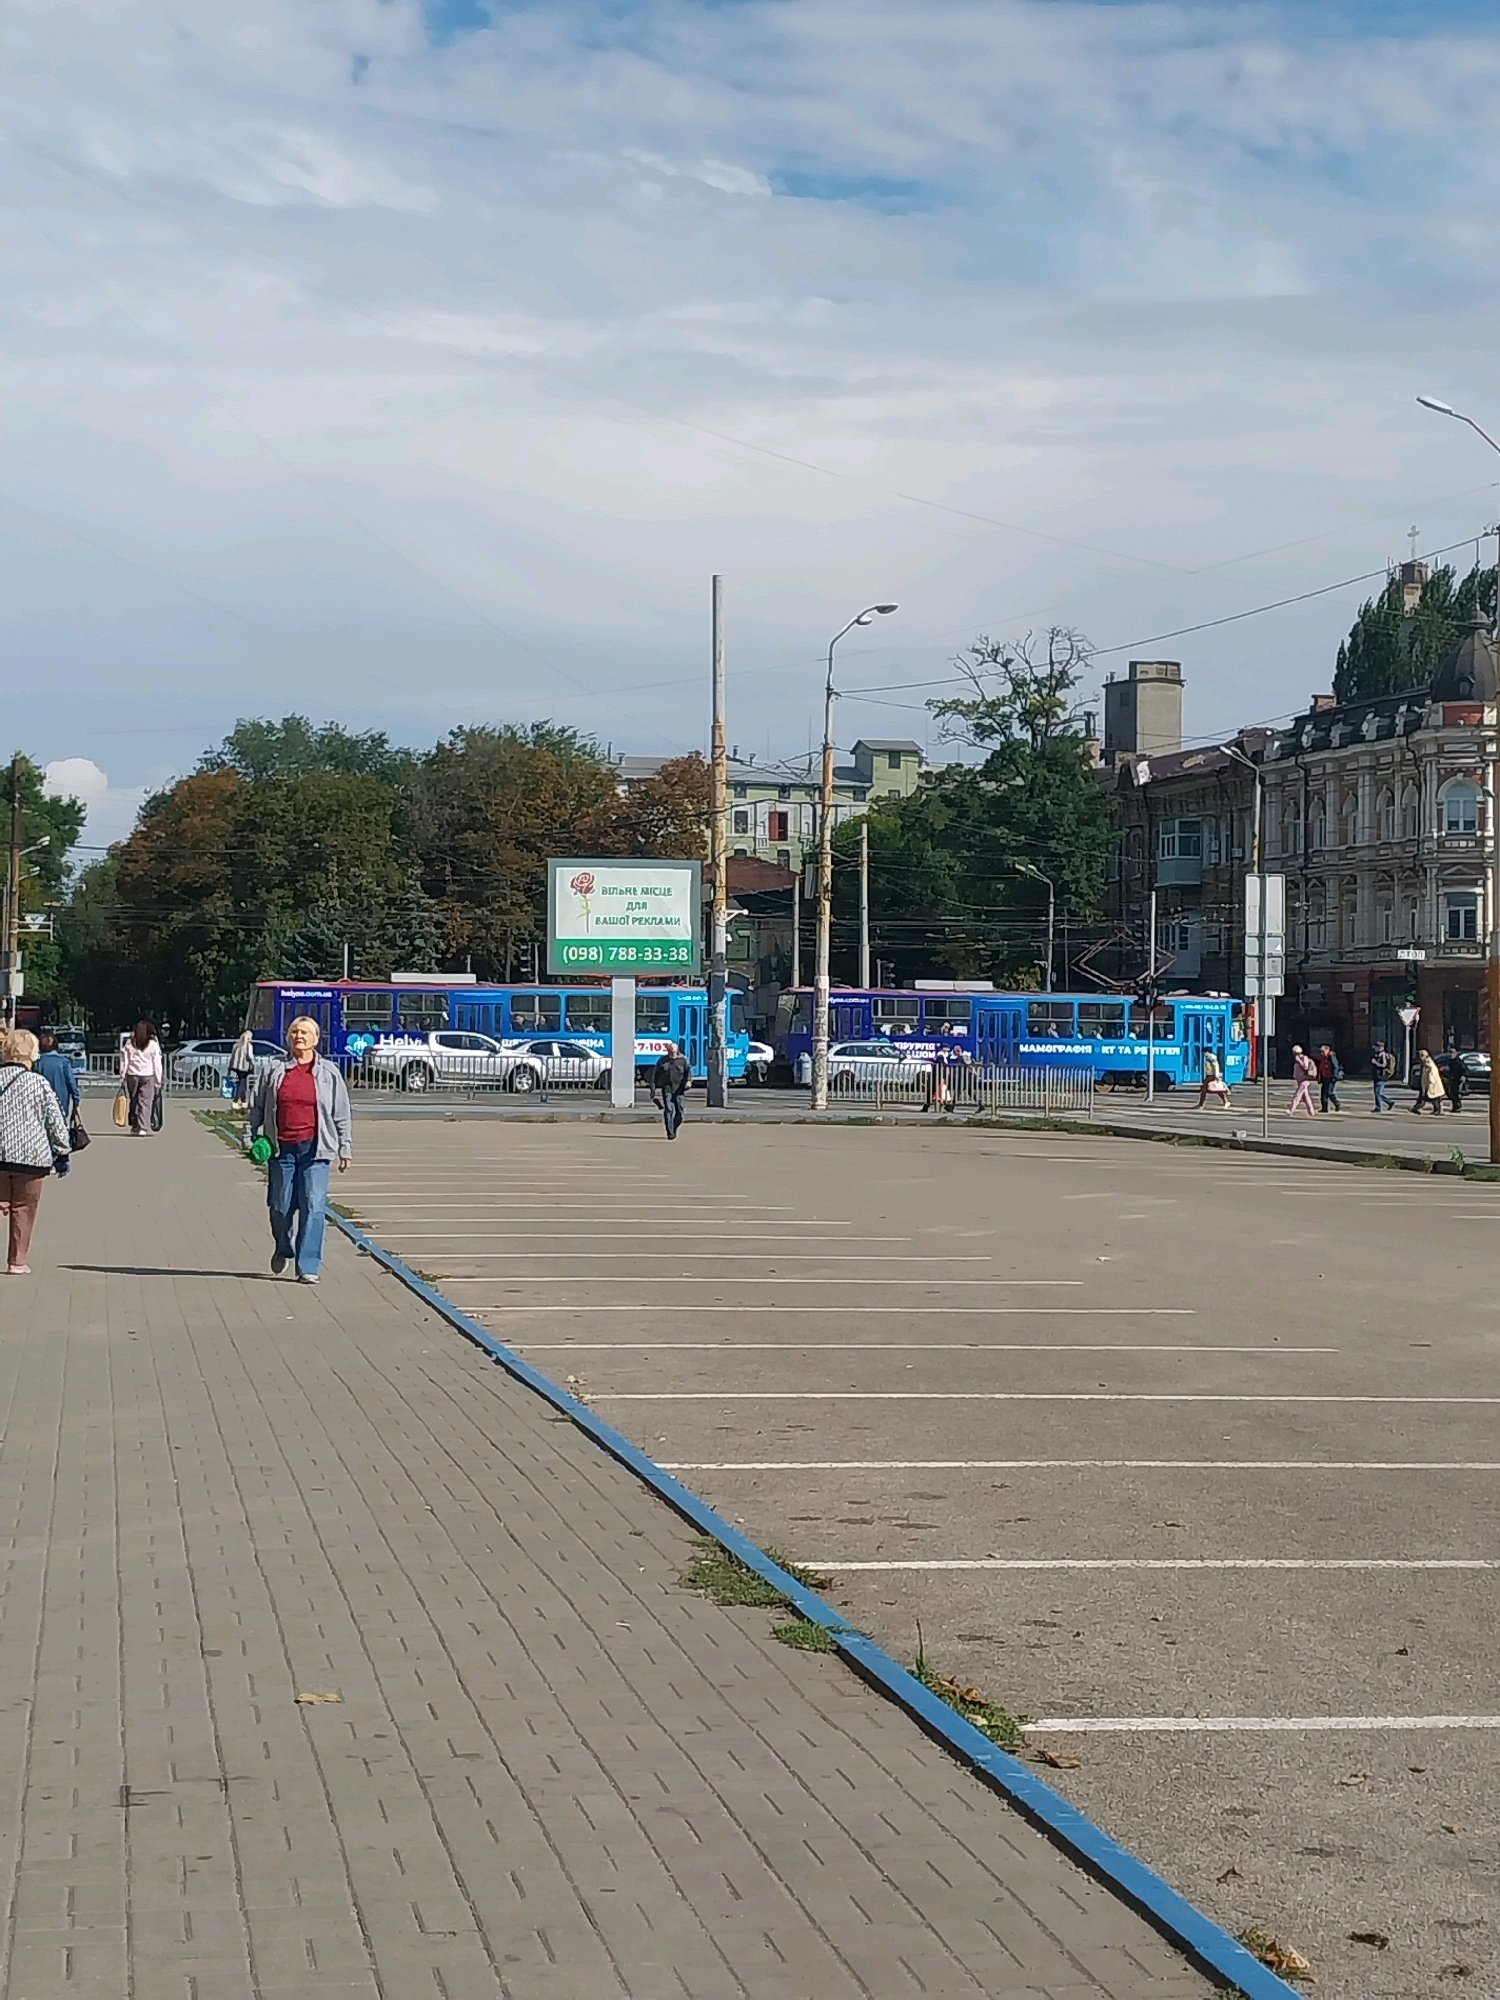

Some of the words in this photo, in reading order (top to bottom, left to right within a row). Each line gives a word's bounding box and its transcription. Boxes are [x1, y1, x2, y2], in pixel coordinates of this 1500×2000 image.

[601, 886, 638, 896] ВІЛЬНЕ
[640, 886, 673, 897] МІСЦЕ
[626, 902, 648, 912] ДЛЯ
[595, 915, 630, 926] ВАШОЇ
[631, 916, 681, 926] РЕКЛАМИ
[563, 945, 603, 963] (098)
[608, 946, 688, 961] 788-33-38
